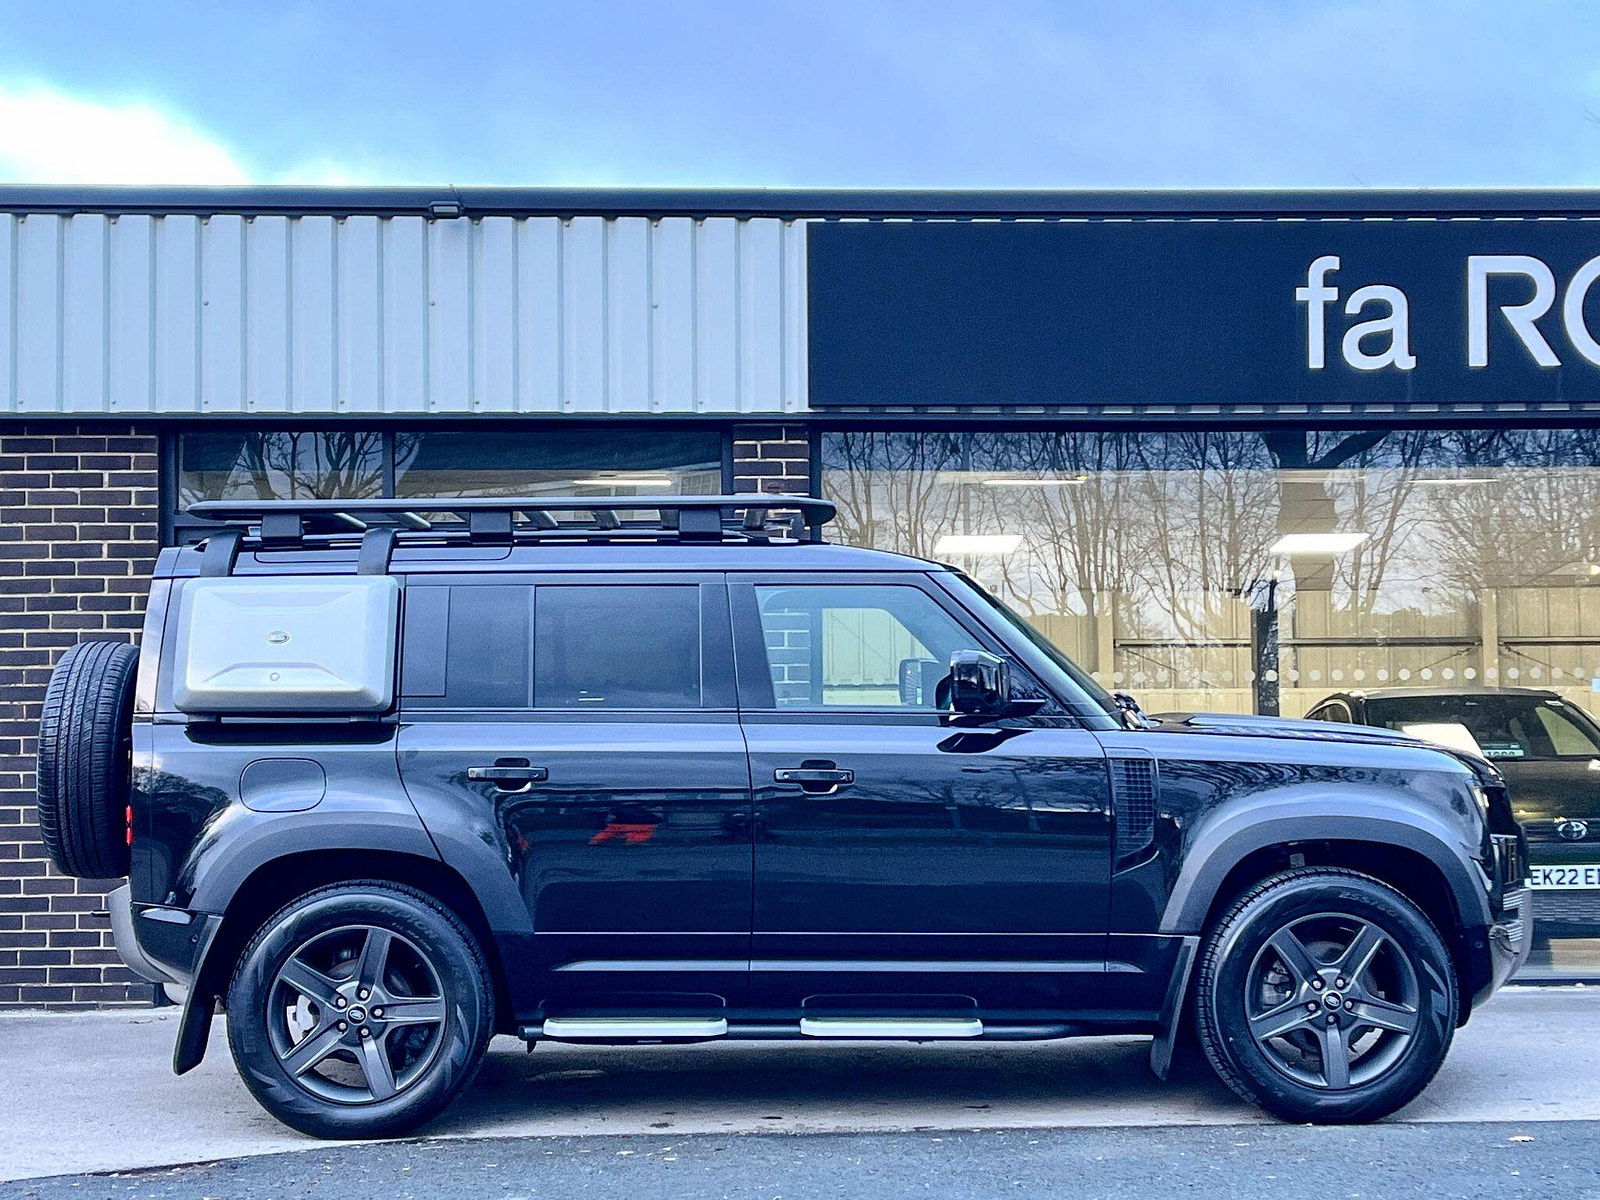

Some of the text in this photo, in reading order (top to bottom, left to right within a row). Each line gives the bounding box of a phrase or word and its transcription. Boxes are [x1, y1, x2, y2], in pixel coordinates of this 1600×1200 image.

[1296, 255, 1417, 370] fa
[1531, 868, 1600, 886] EK22 E
